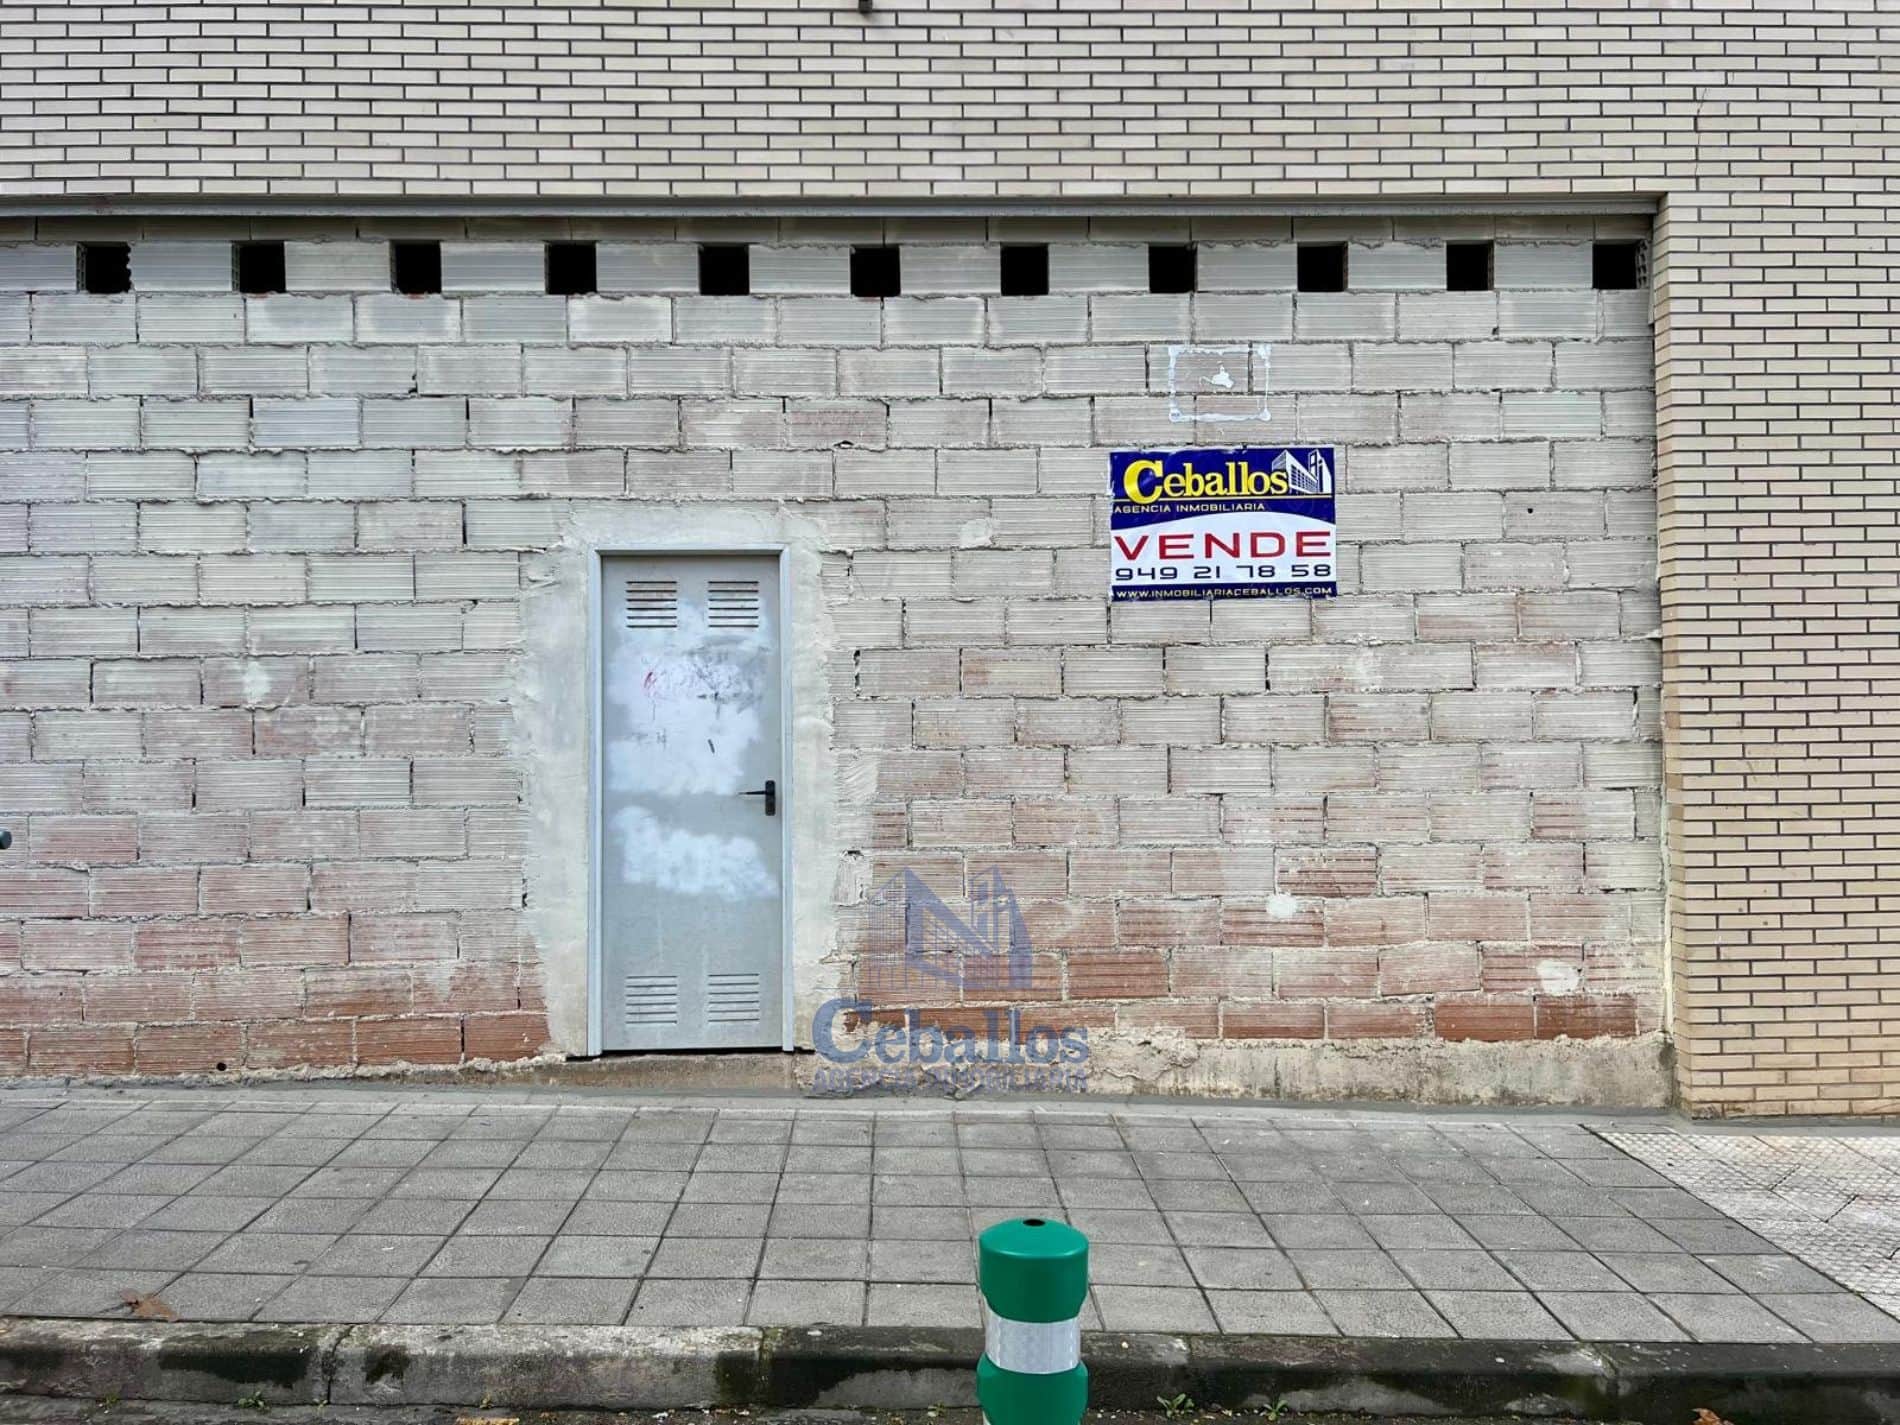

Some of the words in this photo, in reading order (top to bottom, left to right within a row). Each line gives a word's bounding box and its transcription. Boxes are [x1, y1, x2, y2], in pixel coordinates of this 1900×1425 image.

[1123, 460, 1289, 504] Ceballos
[1114, 503, 1171, 513] AGENCIA
[1176, 502, 1265, 512] INMOBILIARIA
[1115, 531, 1331, 560] VENDE
[1115, 566, 1178, 581] 949
[1193, 565, 1220, 578] 21
[1236, 565, 1275, 578] 78
[1291, 564, 1331, 577] 58
[1116, 587, 1332, 599] WWW.INMOBILIARIACEBALLOS.COM
